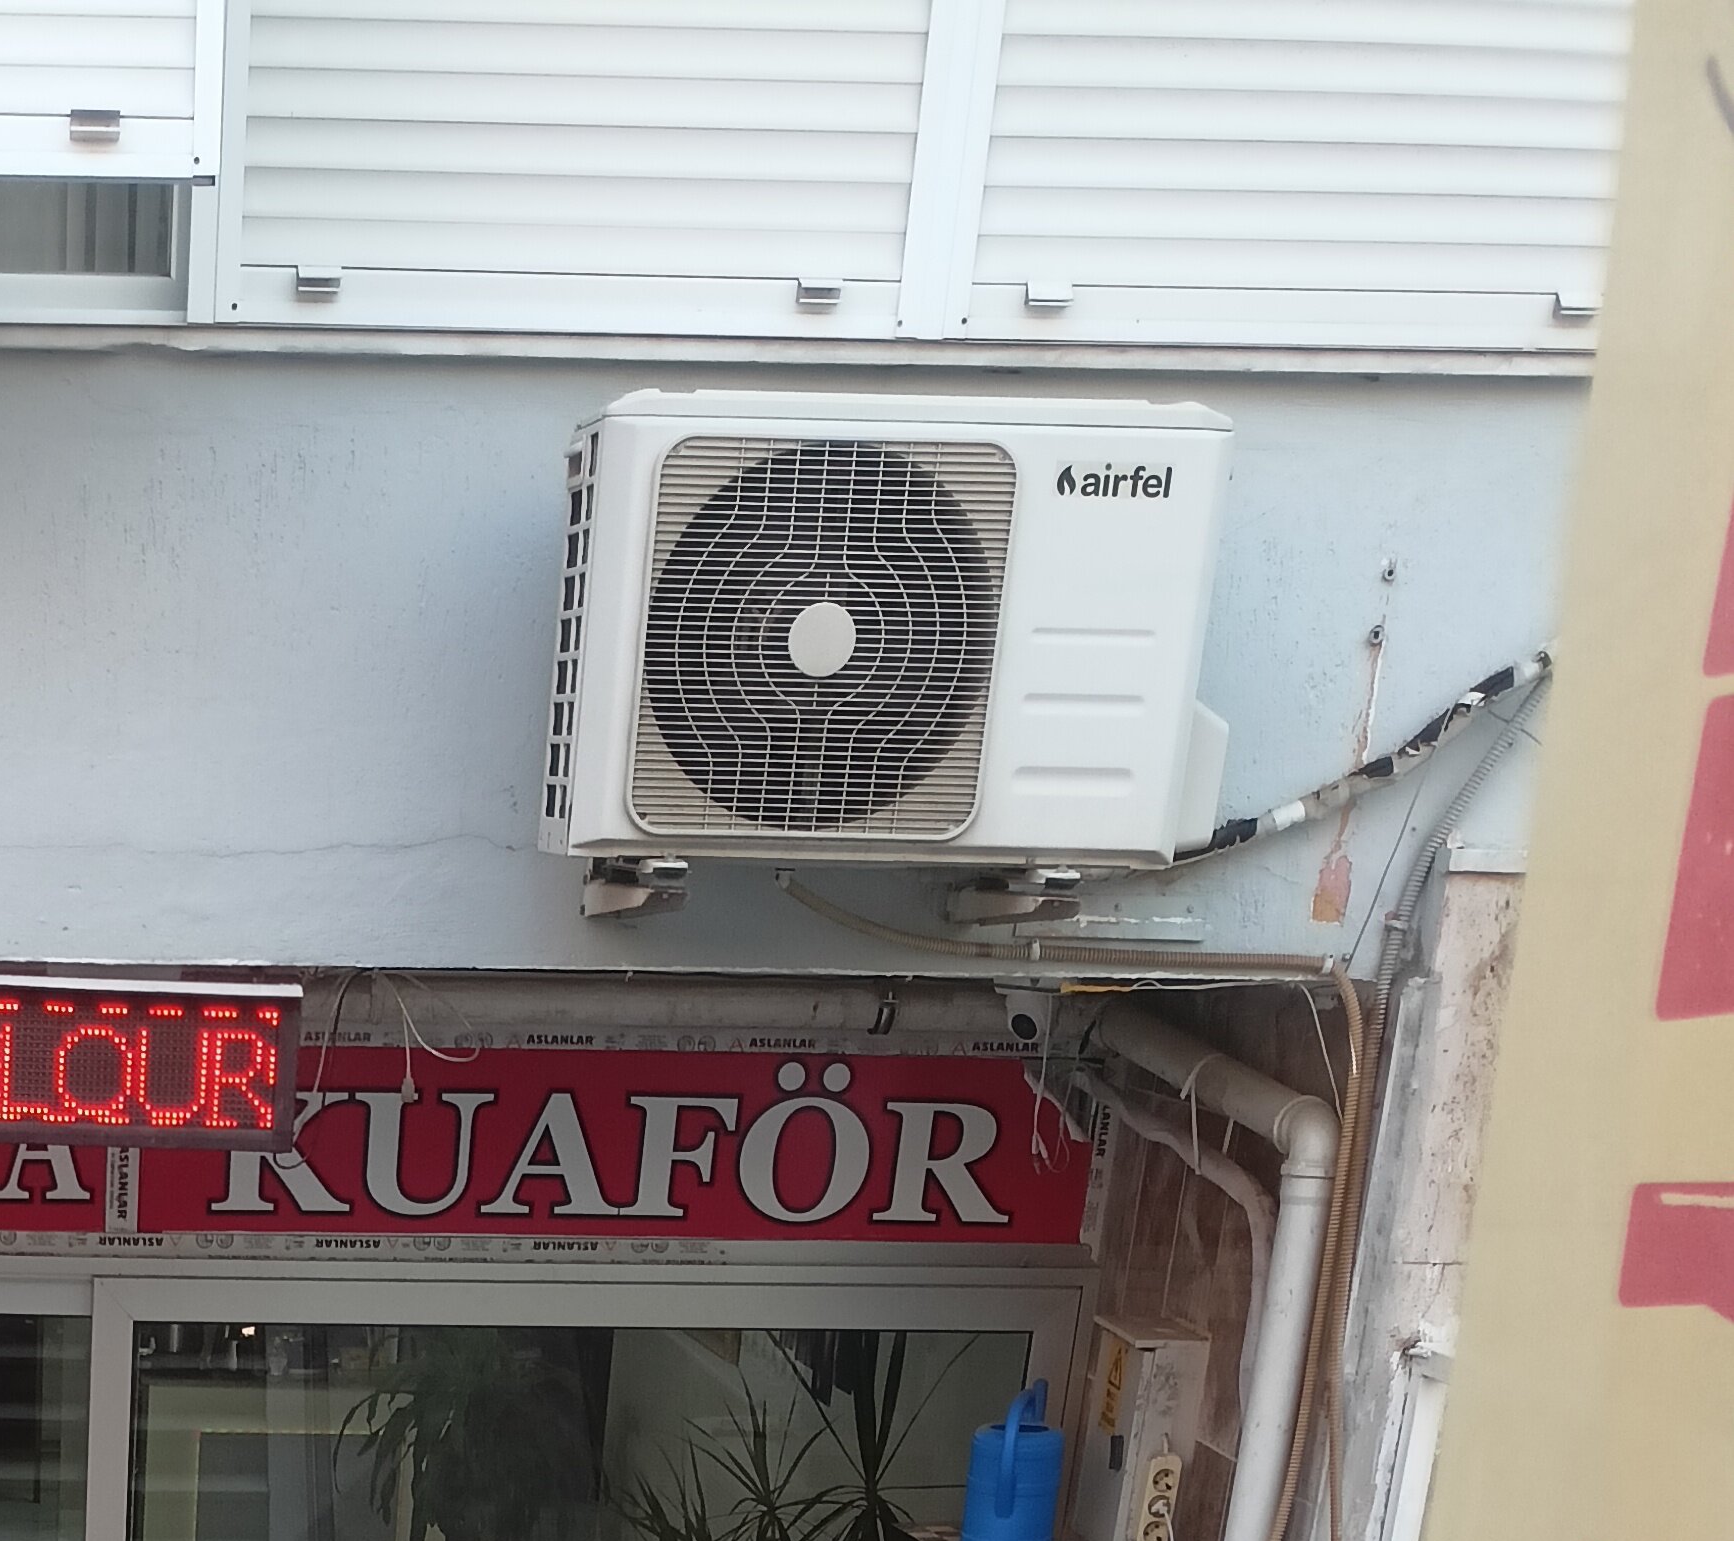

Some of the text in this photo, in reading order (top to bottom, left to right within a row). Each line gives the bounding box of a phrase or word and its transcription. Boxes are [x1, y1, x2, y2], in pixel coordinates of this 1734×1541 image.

[1080, 462, 1173, 498] airfel
[526, 1034, 595, 1046] ASLANLAR
[749, 1037, 817, 1049] ASLANLAR
[972, 1041, 1040, 1053] ASLANLAR
[210, 1062, 1009, 1224] KUAFÖR
[98, 1235, 165, 1247] ASLANLAR
[315, 1237, 382, 1249] ASLANLAR
[532, 1240, 599, 1252] ASLANLAR
